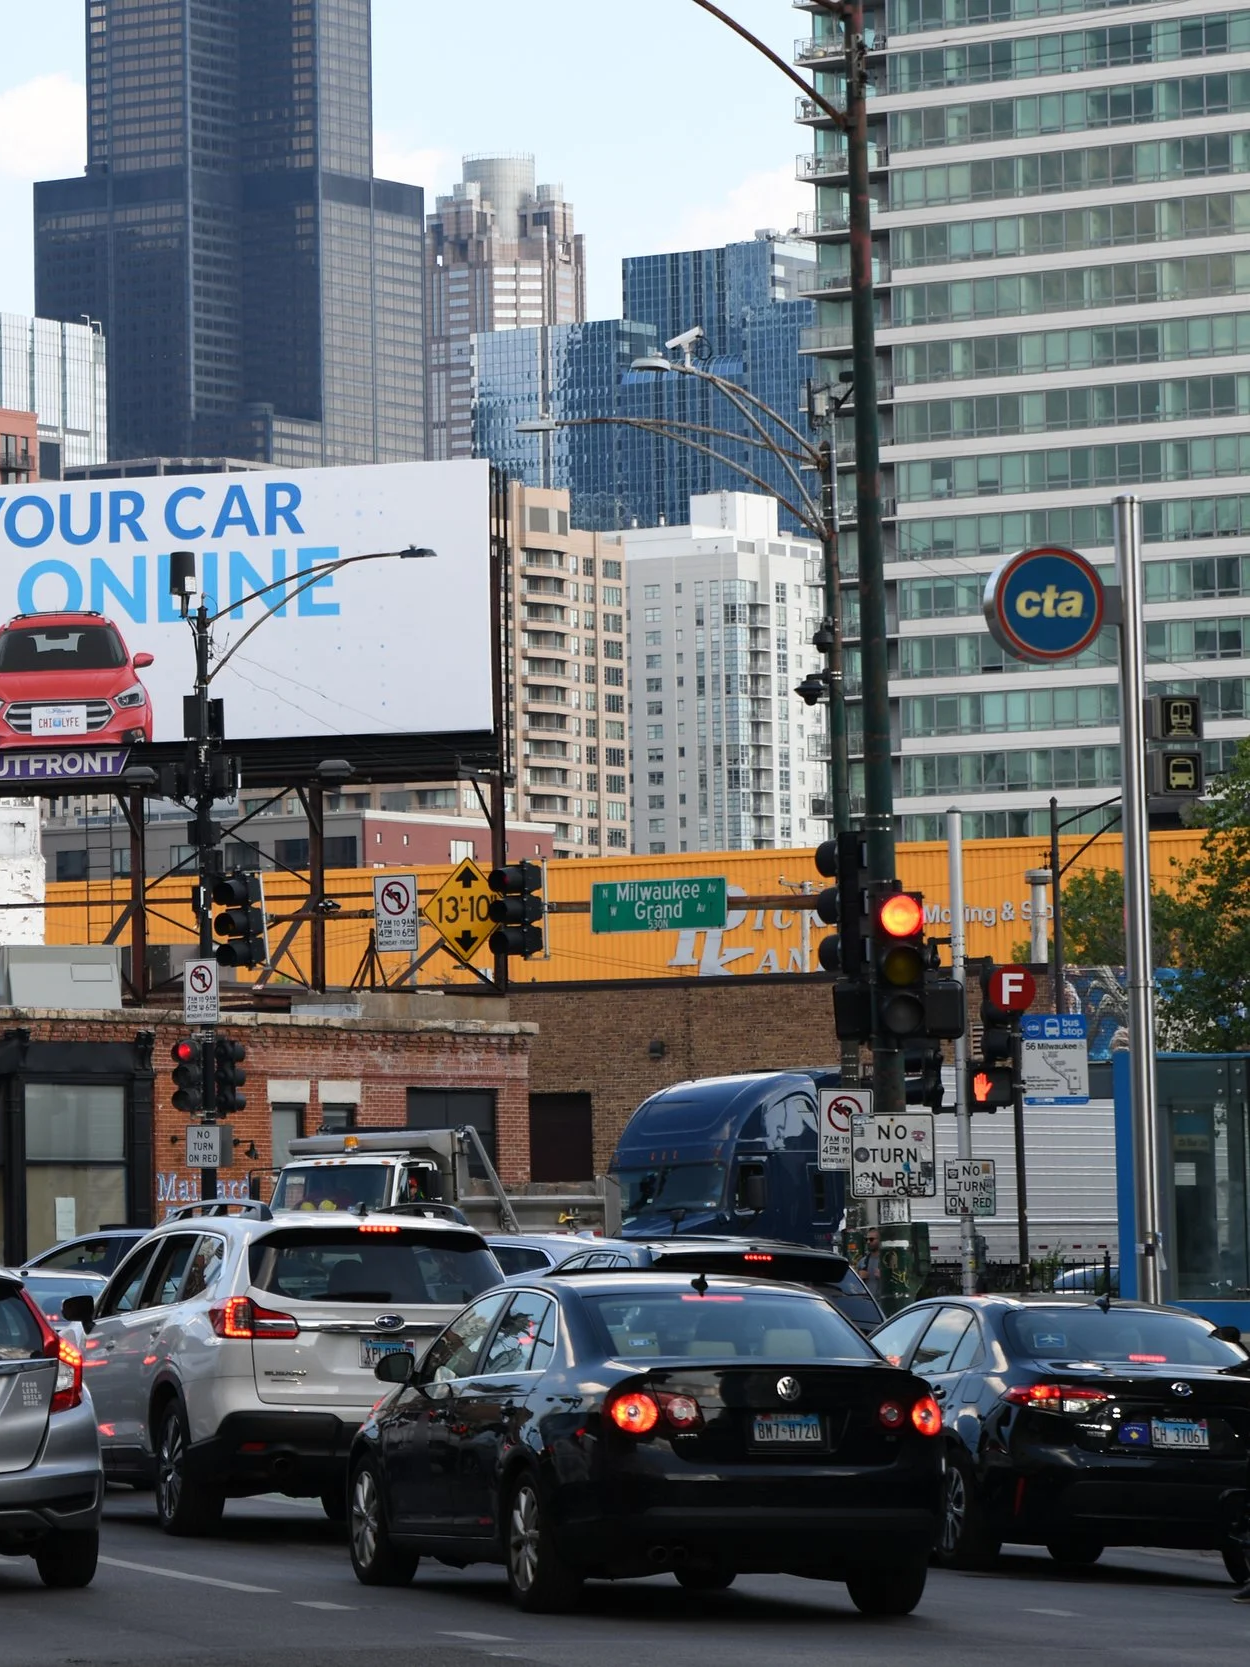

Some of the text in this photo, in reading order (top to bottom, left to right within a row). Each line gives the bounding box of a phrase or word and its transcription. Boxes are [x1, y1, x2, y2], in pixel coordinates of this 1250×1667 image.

[164, 482, 304, 540] CAR
[17, 546, 340, 624] ONLINE
[1016, 584, 1083, 618] cta
[39, 717, 79, 728] CHI LYFE
[602, 882, 716, 902] N Milwaukee Av
[610, 901, 705, 919] W Grand Av
[923, 905, 996, 927] Moing
[1001, 902, 1014, 921] &
[648, 920, 668, 928] 530N
[379, 929, 391, 937] 4PM
[402, 928, 415, 937] 6PM
[1002, 973, 1024, 1004] F
[1062, 1018, 1079, 1026] bus
[1062, 1027, 1083, 1037] stop
[1037, 1042, 1077, 1050] Milwaukee
[197, 1131, 210, 1139] NO
[878, 1125, 907, 1140] NO
[823, 1136, 839, 1144] 7AM
[823, 1146, 839, 1154] 4PM
[202, 1154, 217, 1162] RED
[870, 1148, 918, 1163] TURN
[963, 1166, 979, 1176] NO
[157, 1173, 249, 1201] Maiard
[957, 1181, 986, 1191] TURN
[950, 1197, 991, 1207] ON RED
[1153, 1426, 1206, 1443] CH 37067
